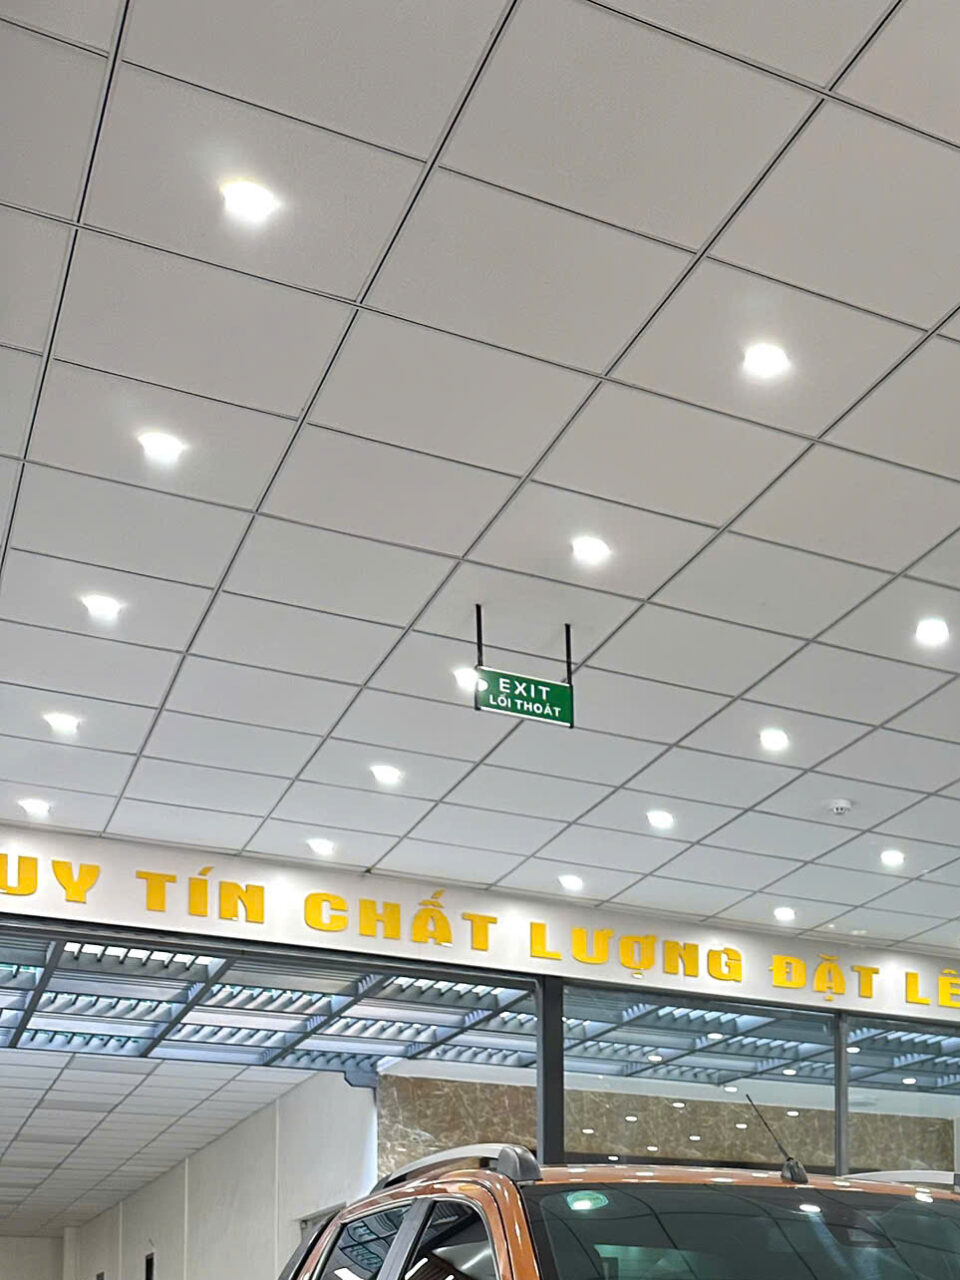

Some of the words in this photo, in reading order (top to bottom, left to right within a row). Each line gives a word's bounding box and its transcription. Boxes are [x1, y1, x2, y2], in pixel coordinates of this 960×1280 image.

[499, 678, 550, 700] EXIT
[489, 693, 511, 708] LỐI
[515, 699, 561, 717] THOÁT
[135, 866, 264, 924] TÍN
[304, 887, 499, 951] CHẤT
[530, 921, 742, 982] LƯỢNG
[768, 953, 879, 1001] ĐẶT
